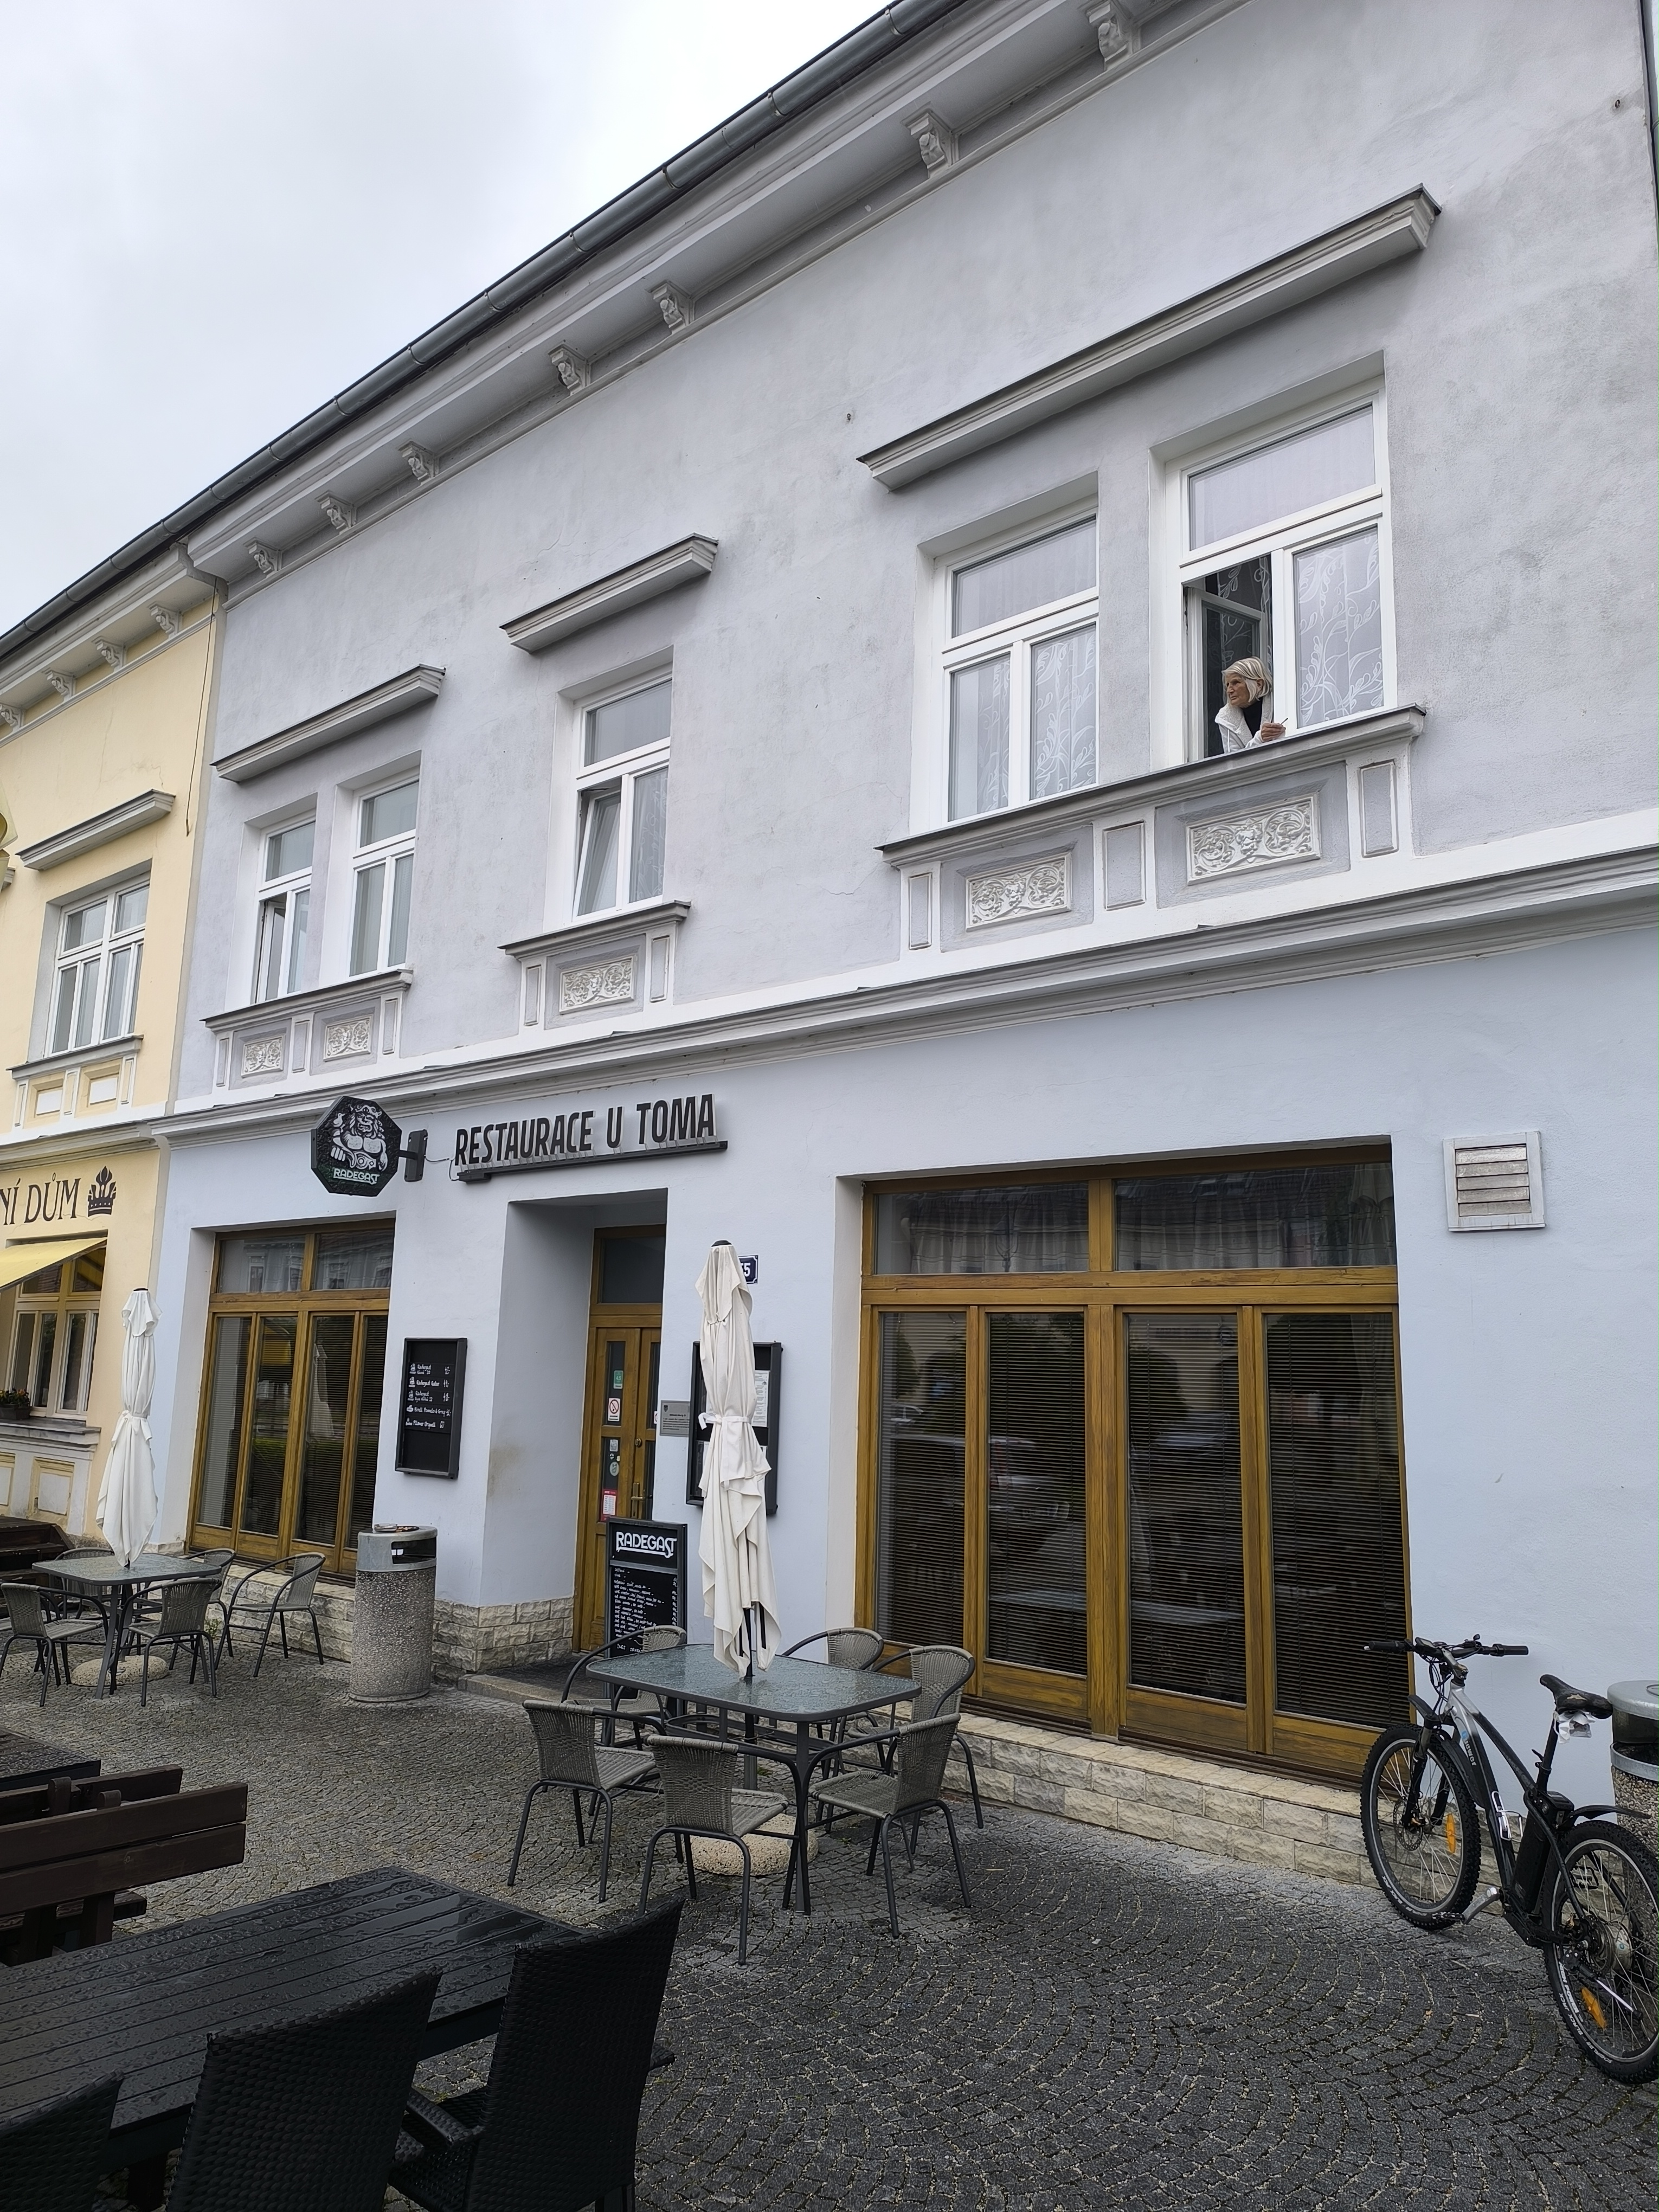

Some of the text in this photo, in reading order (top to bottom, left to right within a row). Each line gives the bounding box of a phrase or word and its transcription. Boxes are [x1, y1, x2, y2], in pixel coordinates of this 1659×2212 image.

[454, 1094, 715, 1166] RESTAURACE U TOMA
[333, 1168, 380, 1185] RADEGAST
[24, 1172, 81, 1224] DŮM
[616, 1531, 677, 1559] RADEGAST
